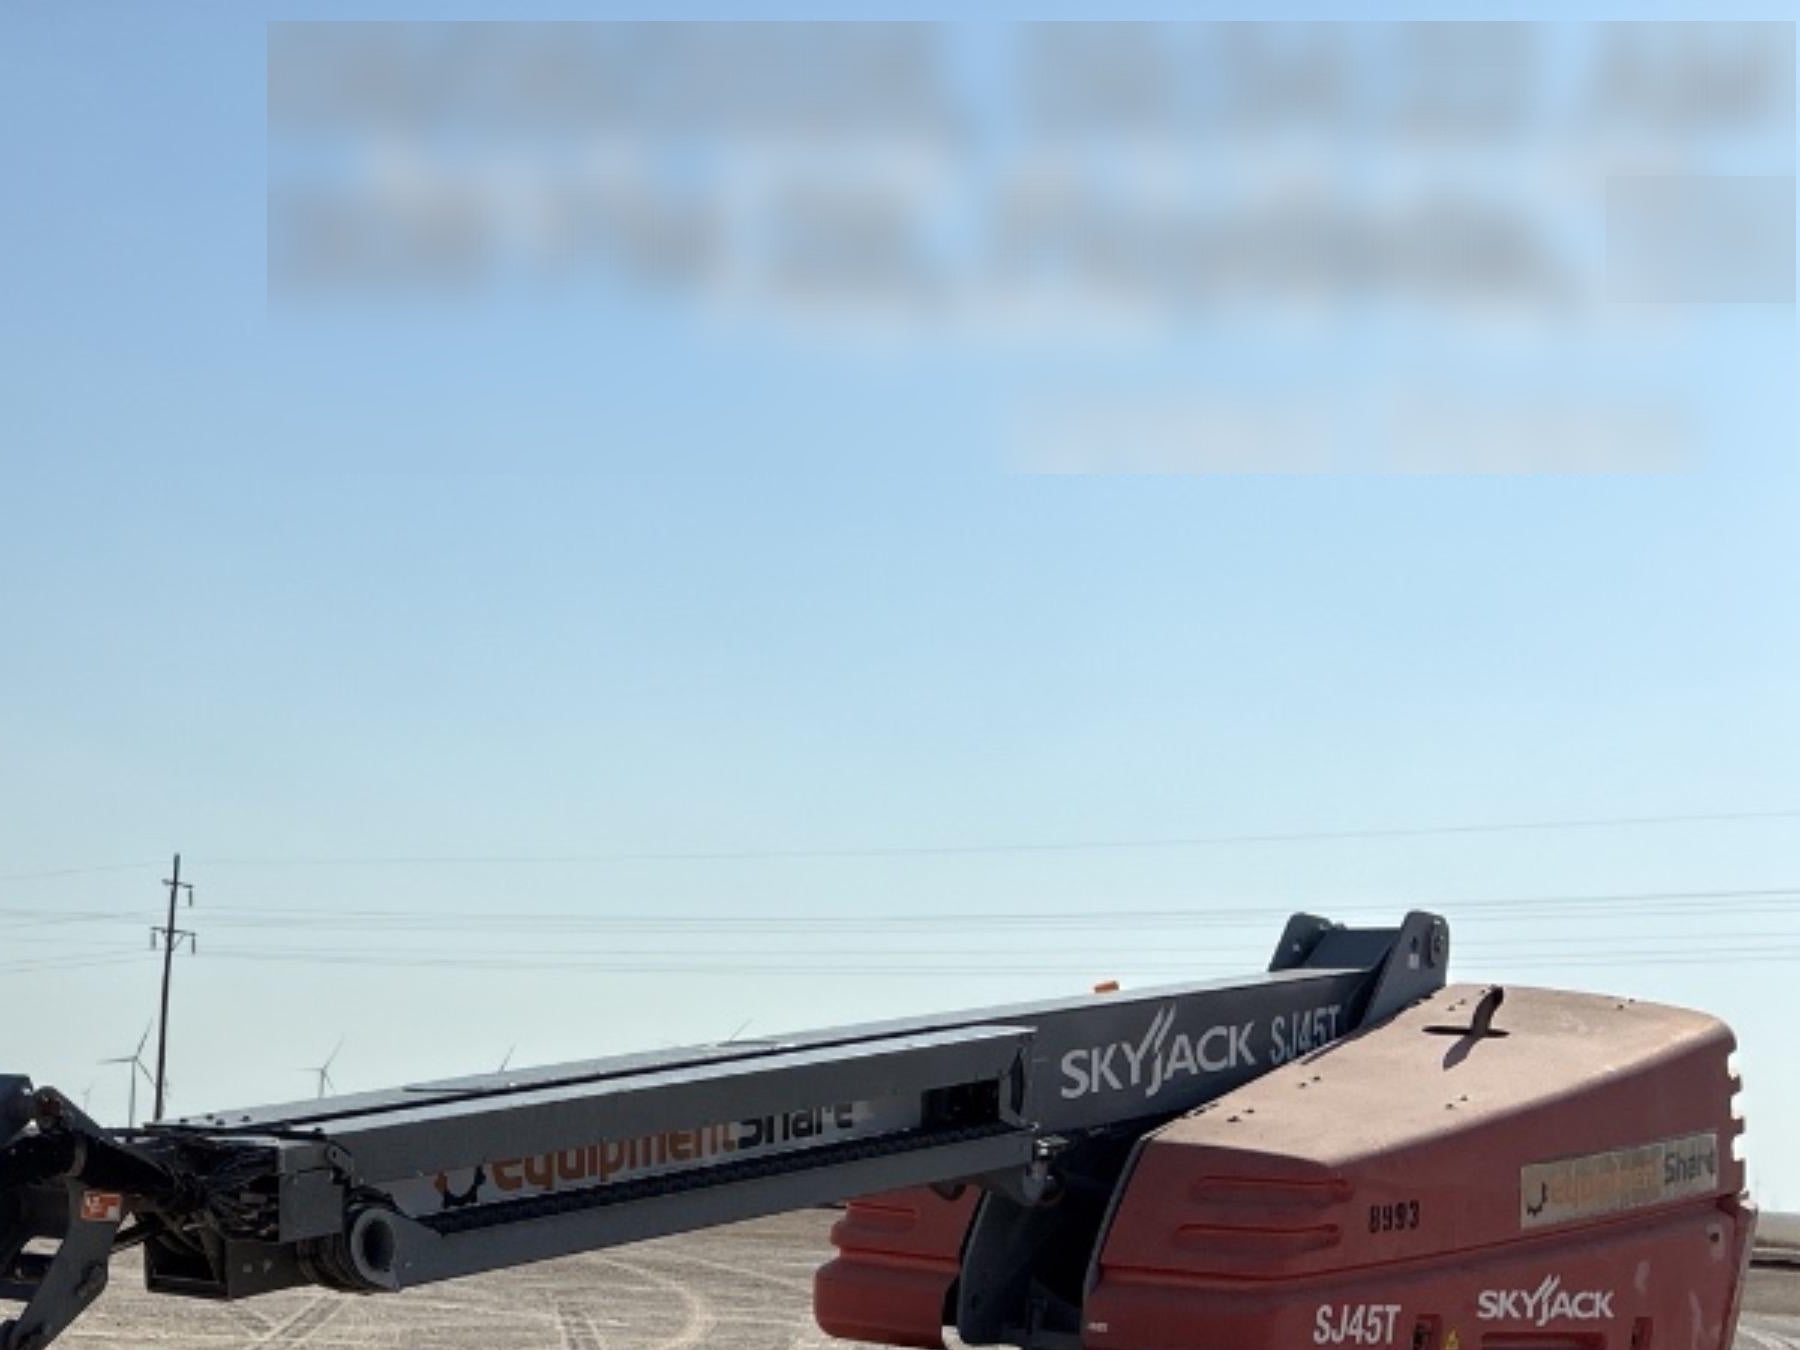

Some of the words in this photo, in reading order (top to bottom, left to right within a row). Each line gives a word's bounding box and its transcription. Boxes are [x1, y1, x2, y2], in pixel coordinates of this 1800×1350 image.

[1061, 1003, 1256, 1098] SKYJACK
[1270, 1005, 1341, 1064] SJ45T
[1313, 1305, 1402, 1344] SJ45T
[1477, 1274, 1614, 1327] SKYJACK
